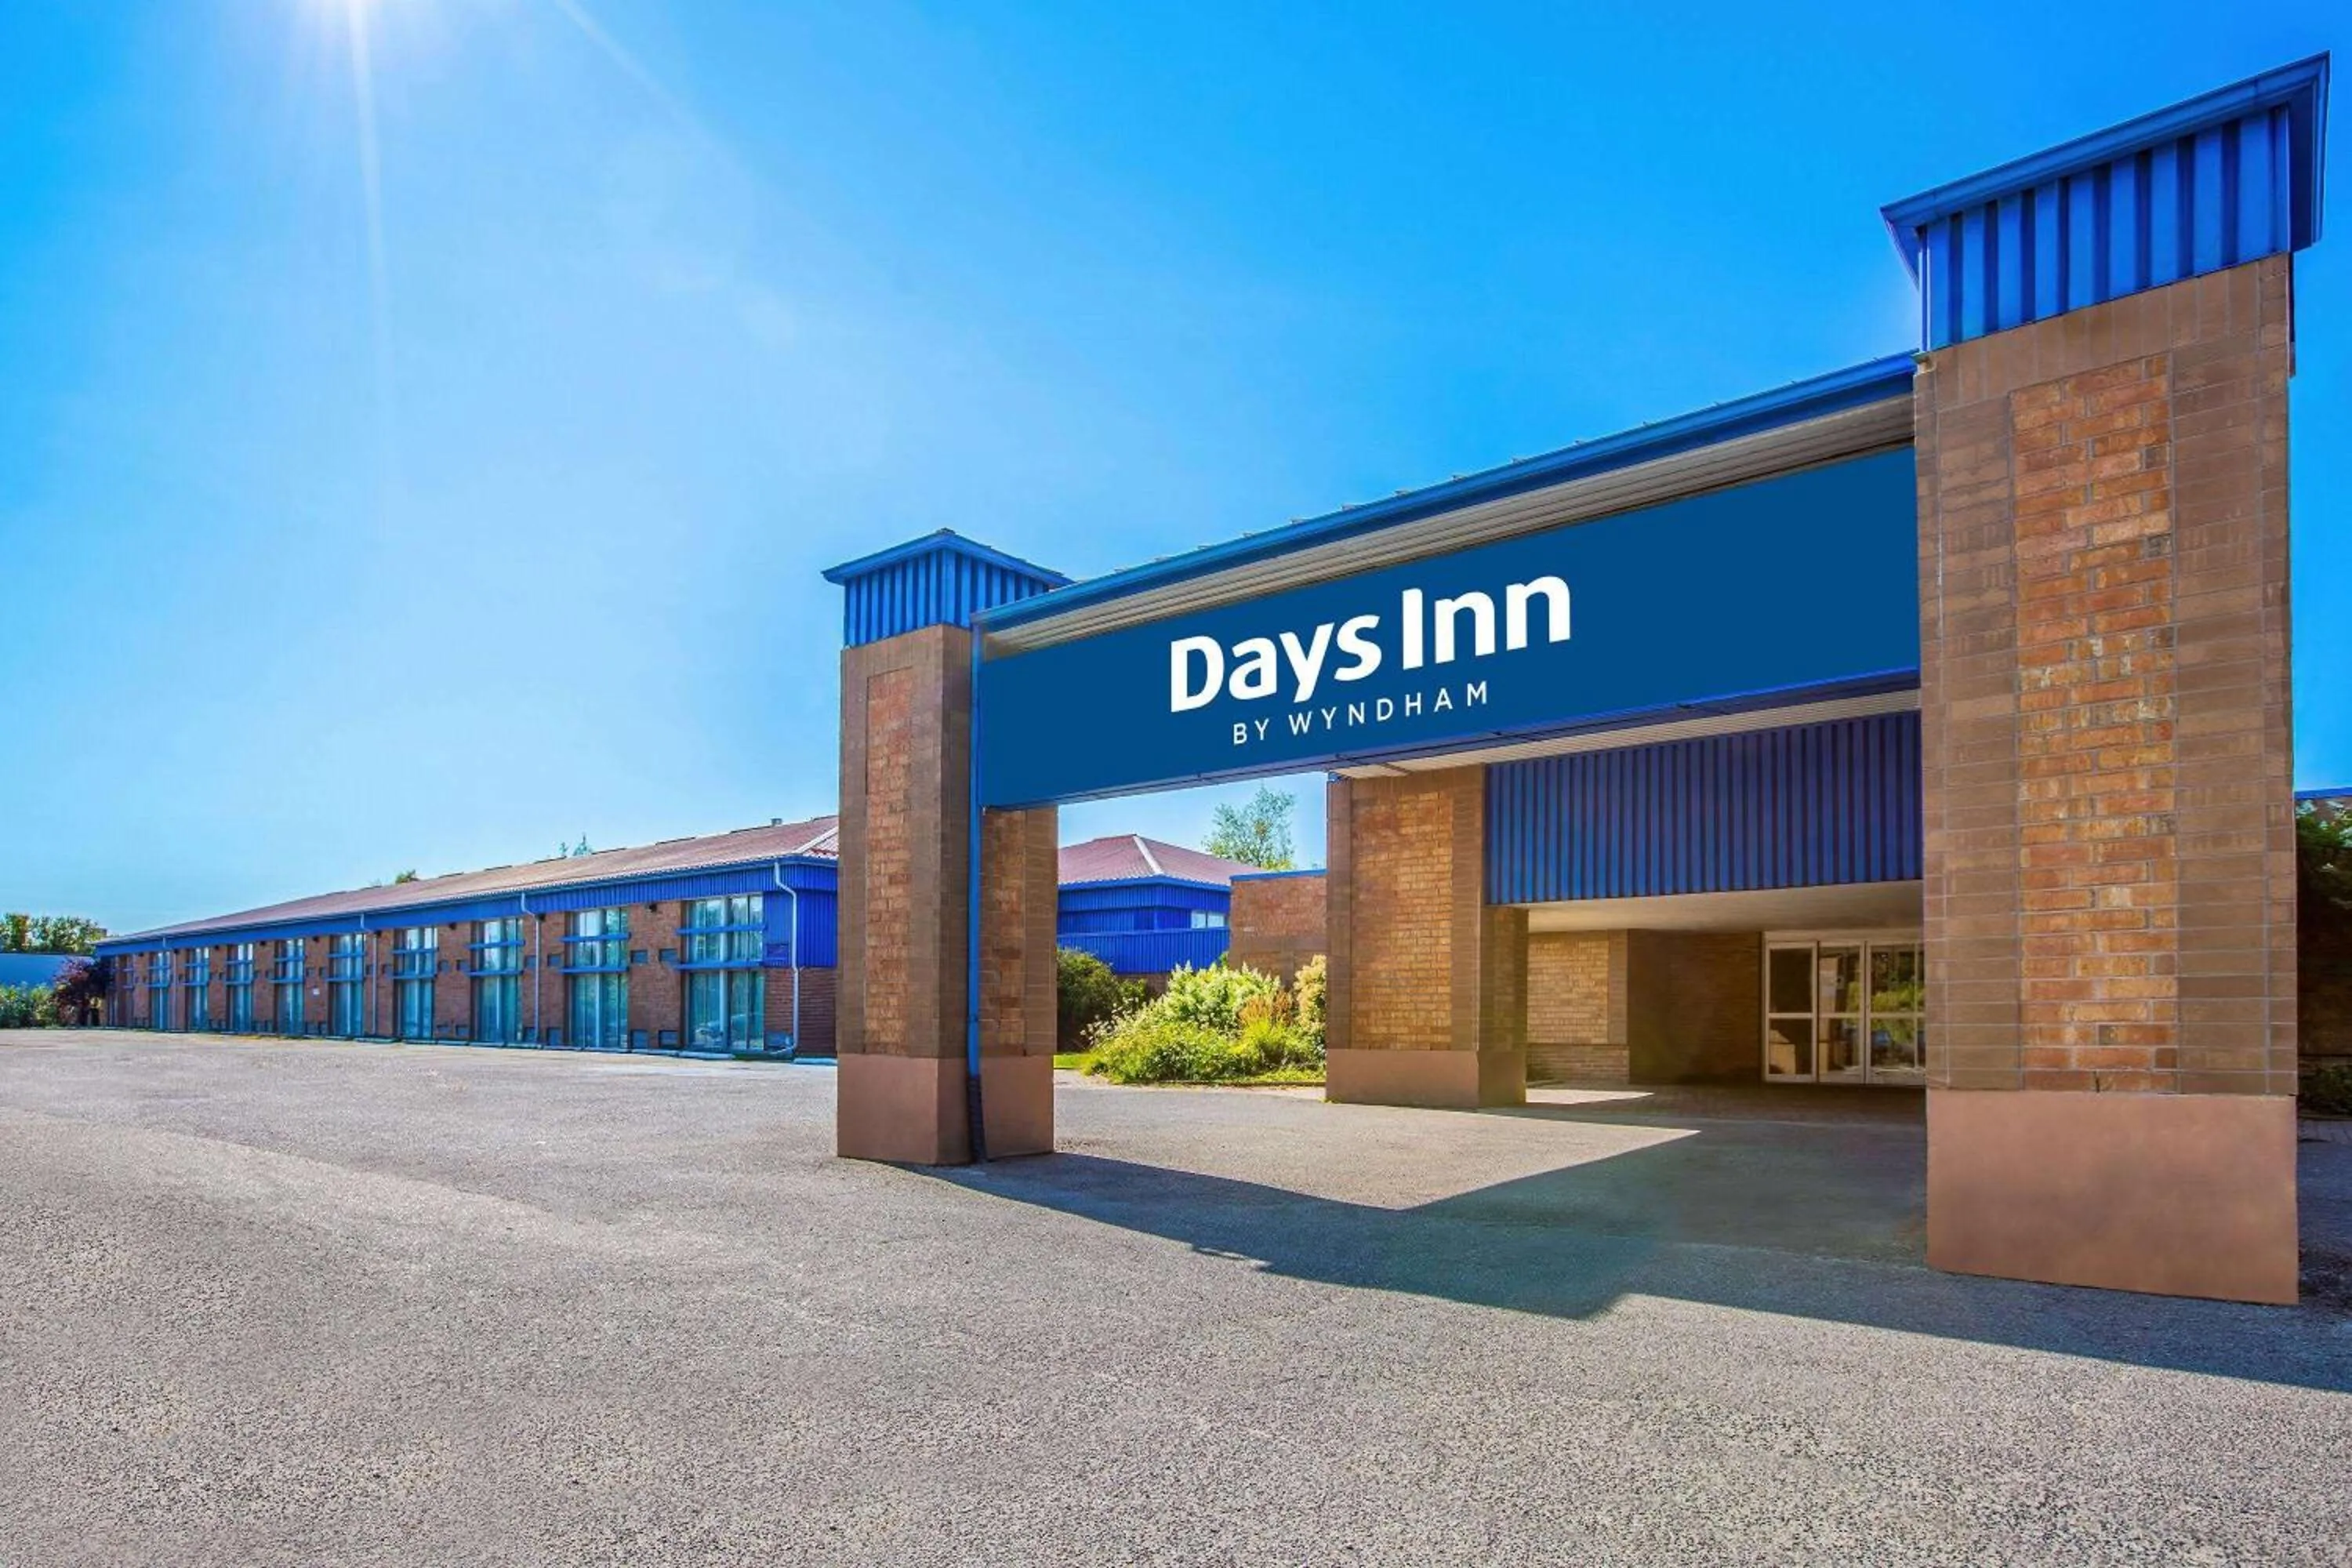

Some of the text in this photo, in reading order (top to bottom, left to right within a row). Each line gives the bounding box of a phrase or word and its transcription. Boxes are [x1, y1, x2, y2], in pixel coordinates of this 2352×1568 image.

[1171, 575, 1570, 713] Days Inn
[1233, 681, 1487, 745] BY WYNDHAM
